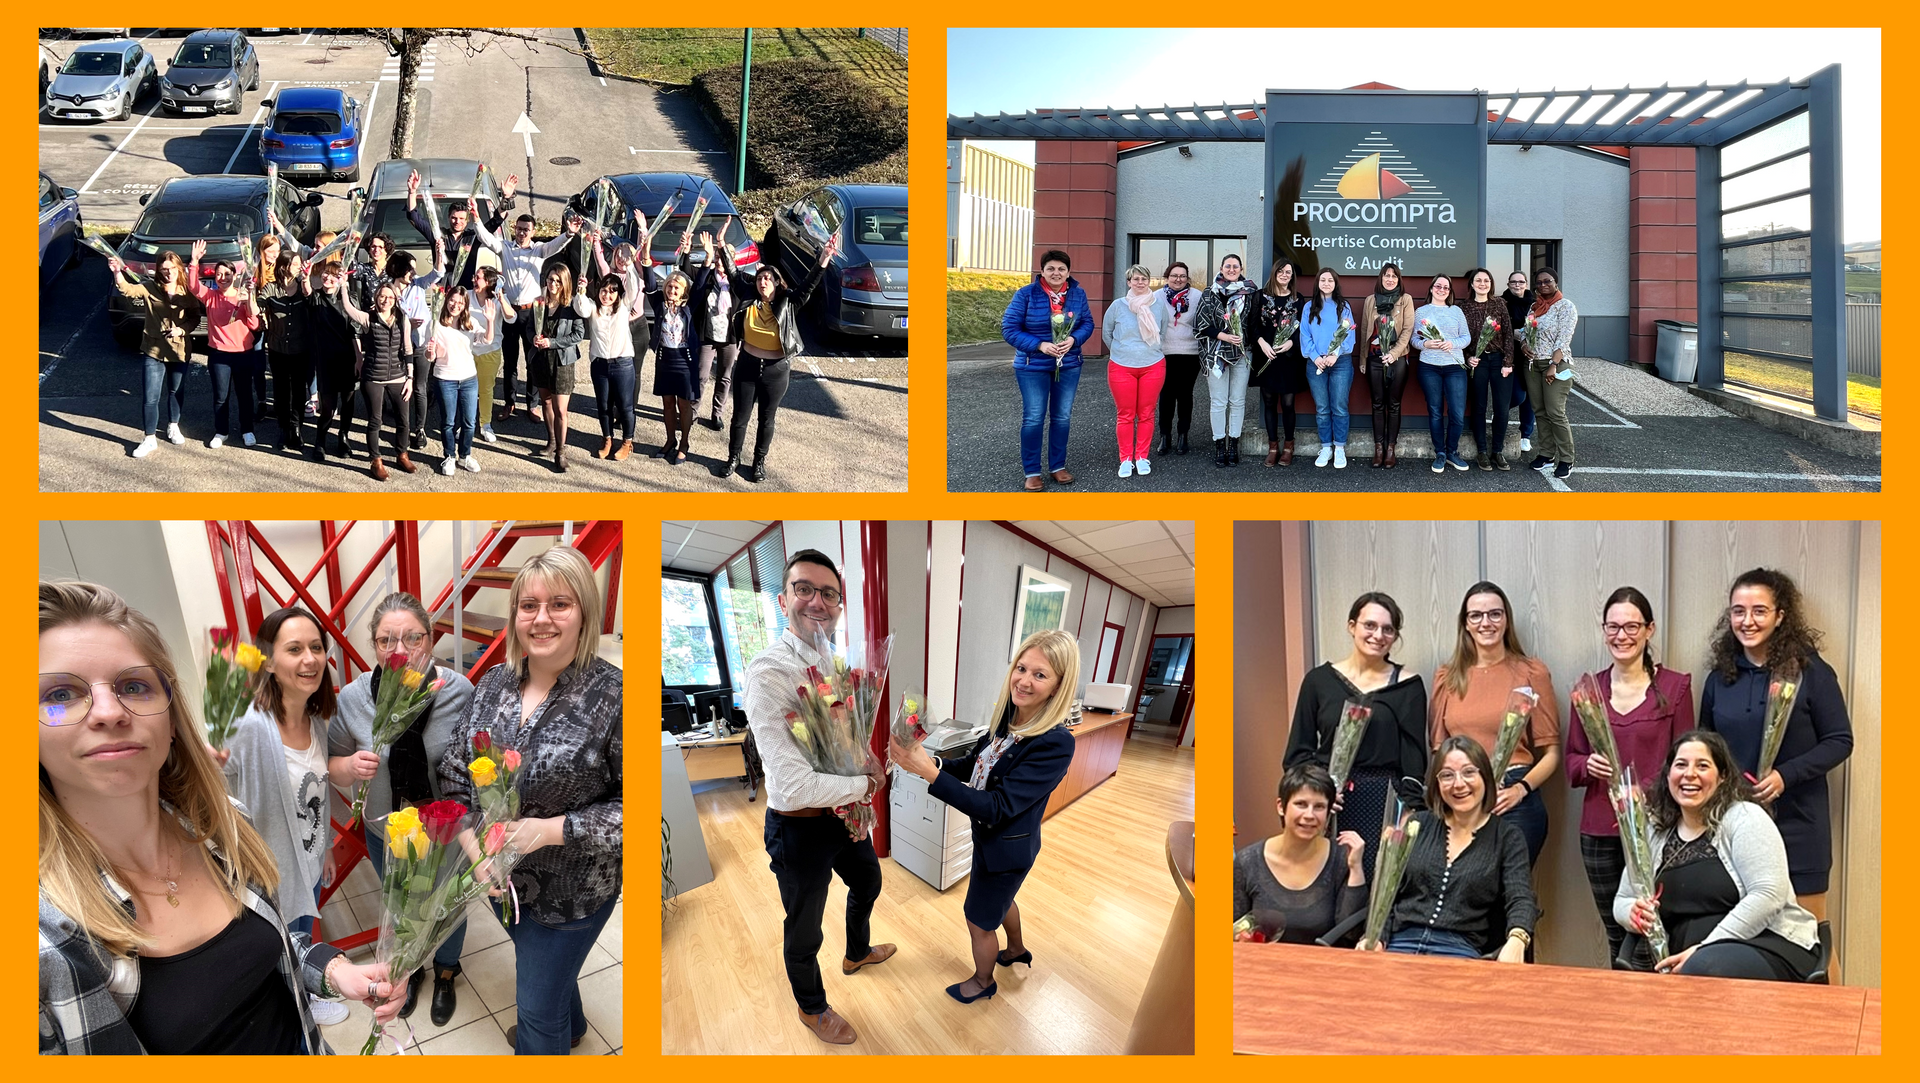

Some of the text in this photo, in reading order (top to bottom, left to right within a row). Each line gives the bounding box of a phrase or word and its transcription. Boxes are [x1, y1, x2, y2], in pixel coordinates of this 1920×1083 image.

[1293, 233, 1457, 251] Expertise Comptable
[1344, 256, 1404, 270] & Audit
